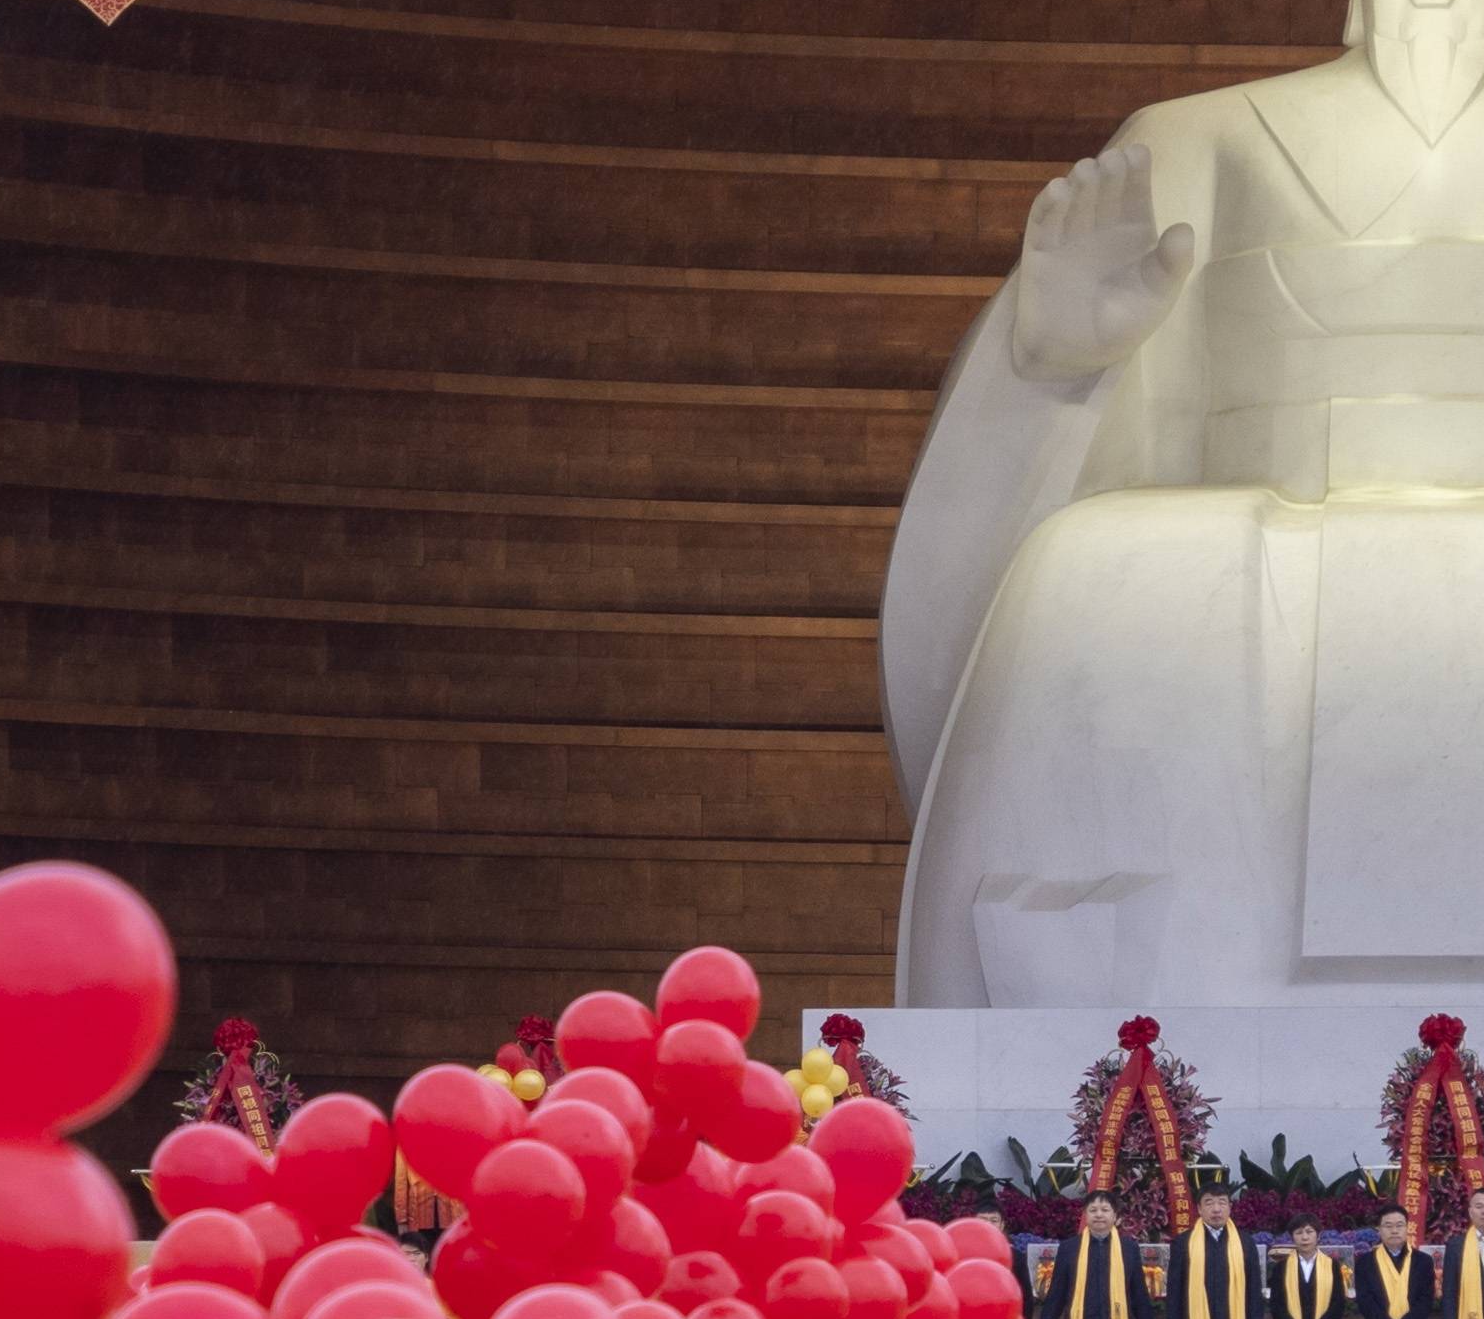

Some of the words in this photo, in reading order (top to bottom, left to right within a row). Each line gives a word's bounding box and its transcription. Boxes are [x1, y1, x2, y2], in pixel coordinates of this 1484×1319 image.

[1146, 1084, 1178, 1162] 同根同祖同源
[1449, 1081, 1478, 1160] 同根同祖同源
